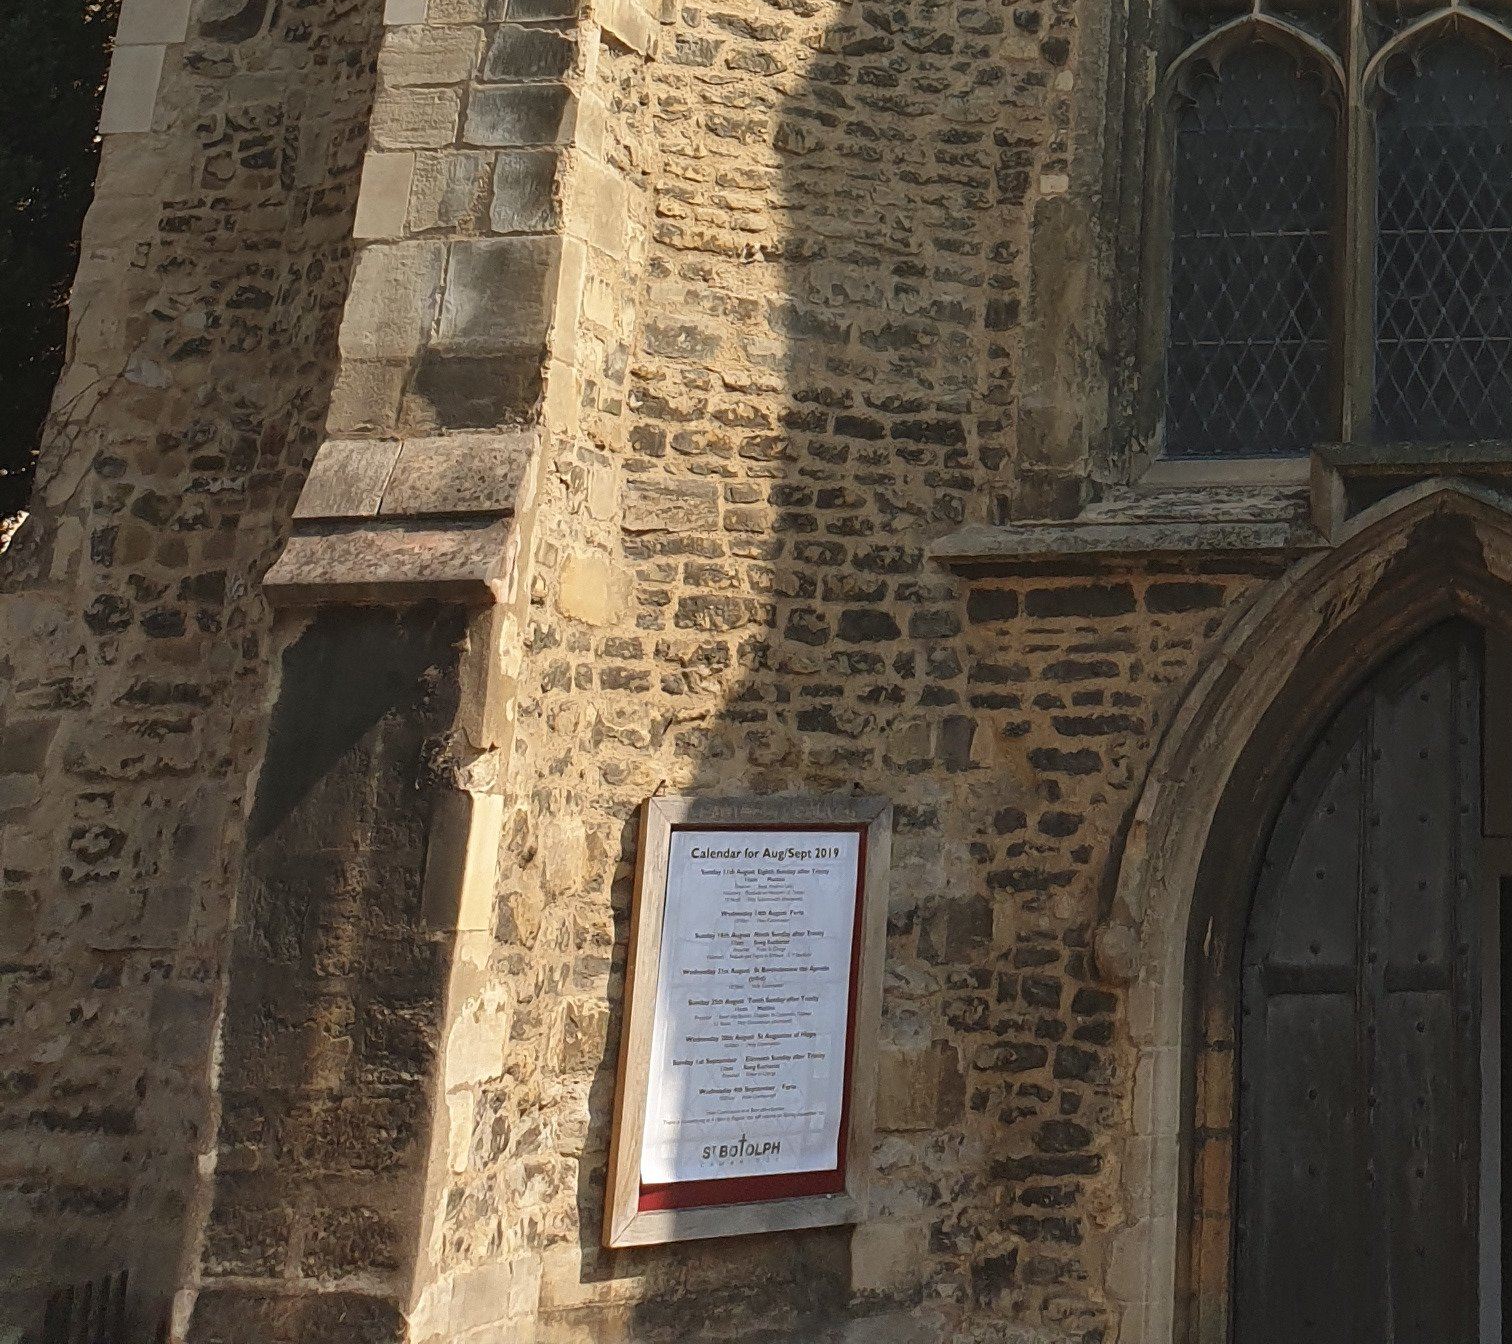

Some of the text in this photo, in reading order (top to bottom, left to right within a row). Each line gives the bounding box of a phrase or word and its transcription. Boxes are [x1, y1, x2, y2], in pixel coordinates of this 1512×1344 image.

[691, 847, 840, 862] Calendar for Aug/Sept 2019
[719, 1133, 781, 1159] BOTOLPH
